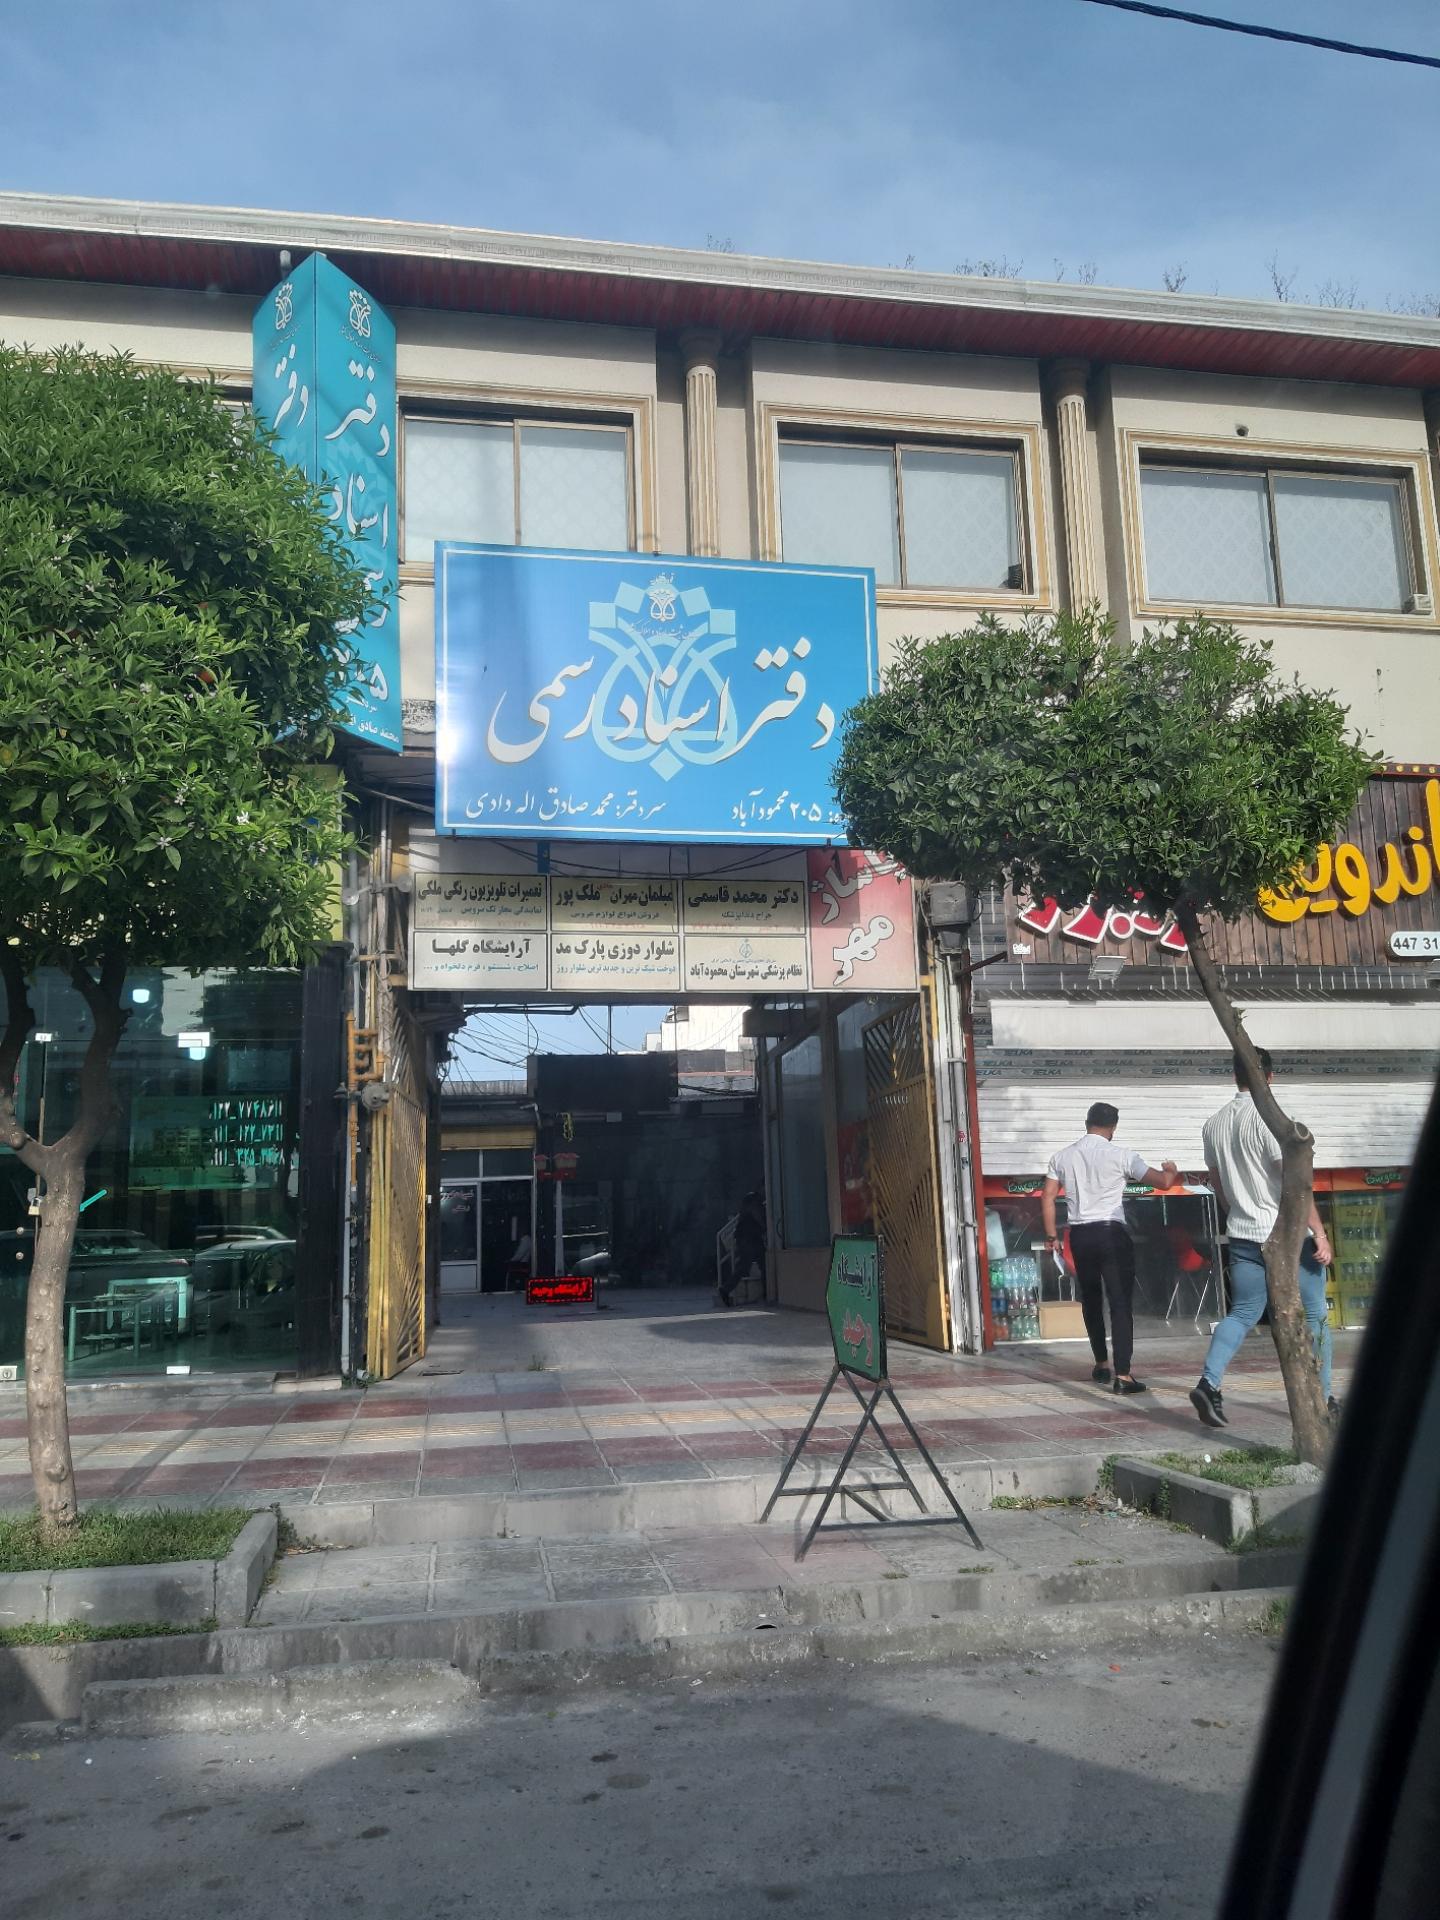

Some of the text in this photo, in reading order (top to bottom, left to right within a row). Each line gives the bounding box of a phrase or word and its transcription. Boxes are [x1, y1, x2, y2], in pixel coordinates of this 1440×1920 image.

[323, 359, 391, 457] دفتر
[487, 636, 836, 766] دفتر اسناد رسمی
[538, 786, 590, 820] صادق
[590, 792, 615, 817] محمد
[790, 802, 822, 822] ۲۰۵
[418, 879, 543, 903] تعمیرات تلویزیون رنگی ملکی
[555, 883, 674, 907] مبلمان مهران ملک پور
[688, 884, 799, 909] دکتر محمد قاسمی
[472, 938, 532, 959] آرایشگاه
[555, 939, 675, 961] شلوار دوزی پارک مد
[1393, 937, 1418, 950] 447
[728, 963, 760, 980] شهرستان
[760, 963, 786, 980] پزشکی
[786, 963, 803, 979] نظام
